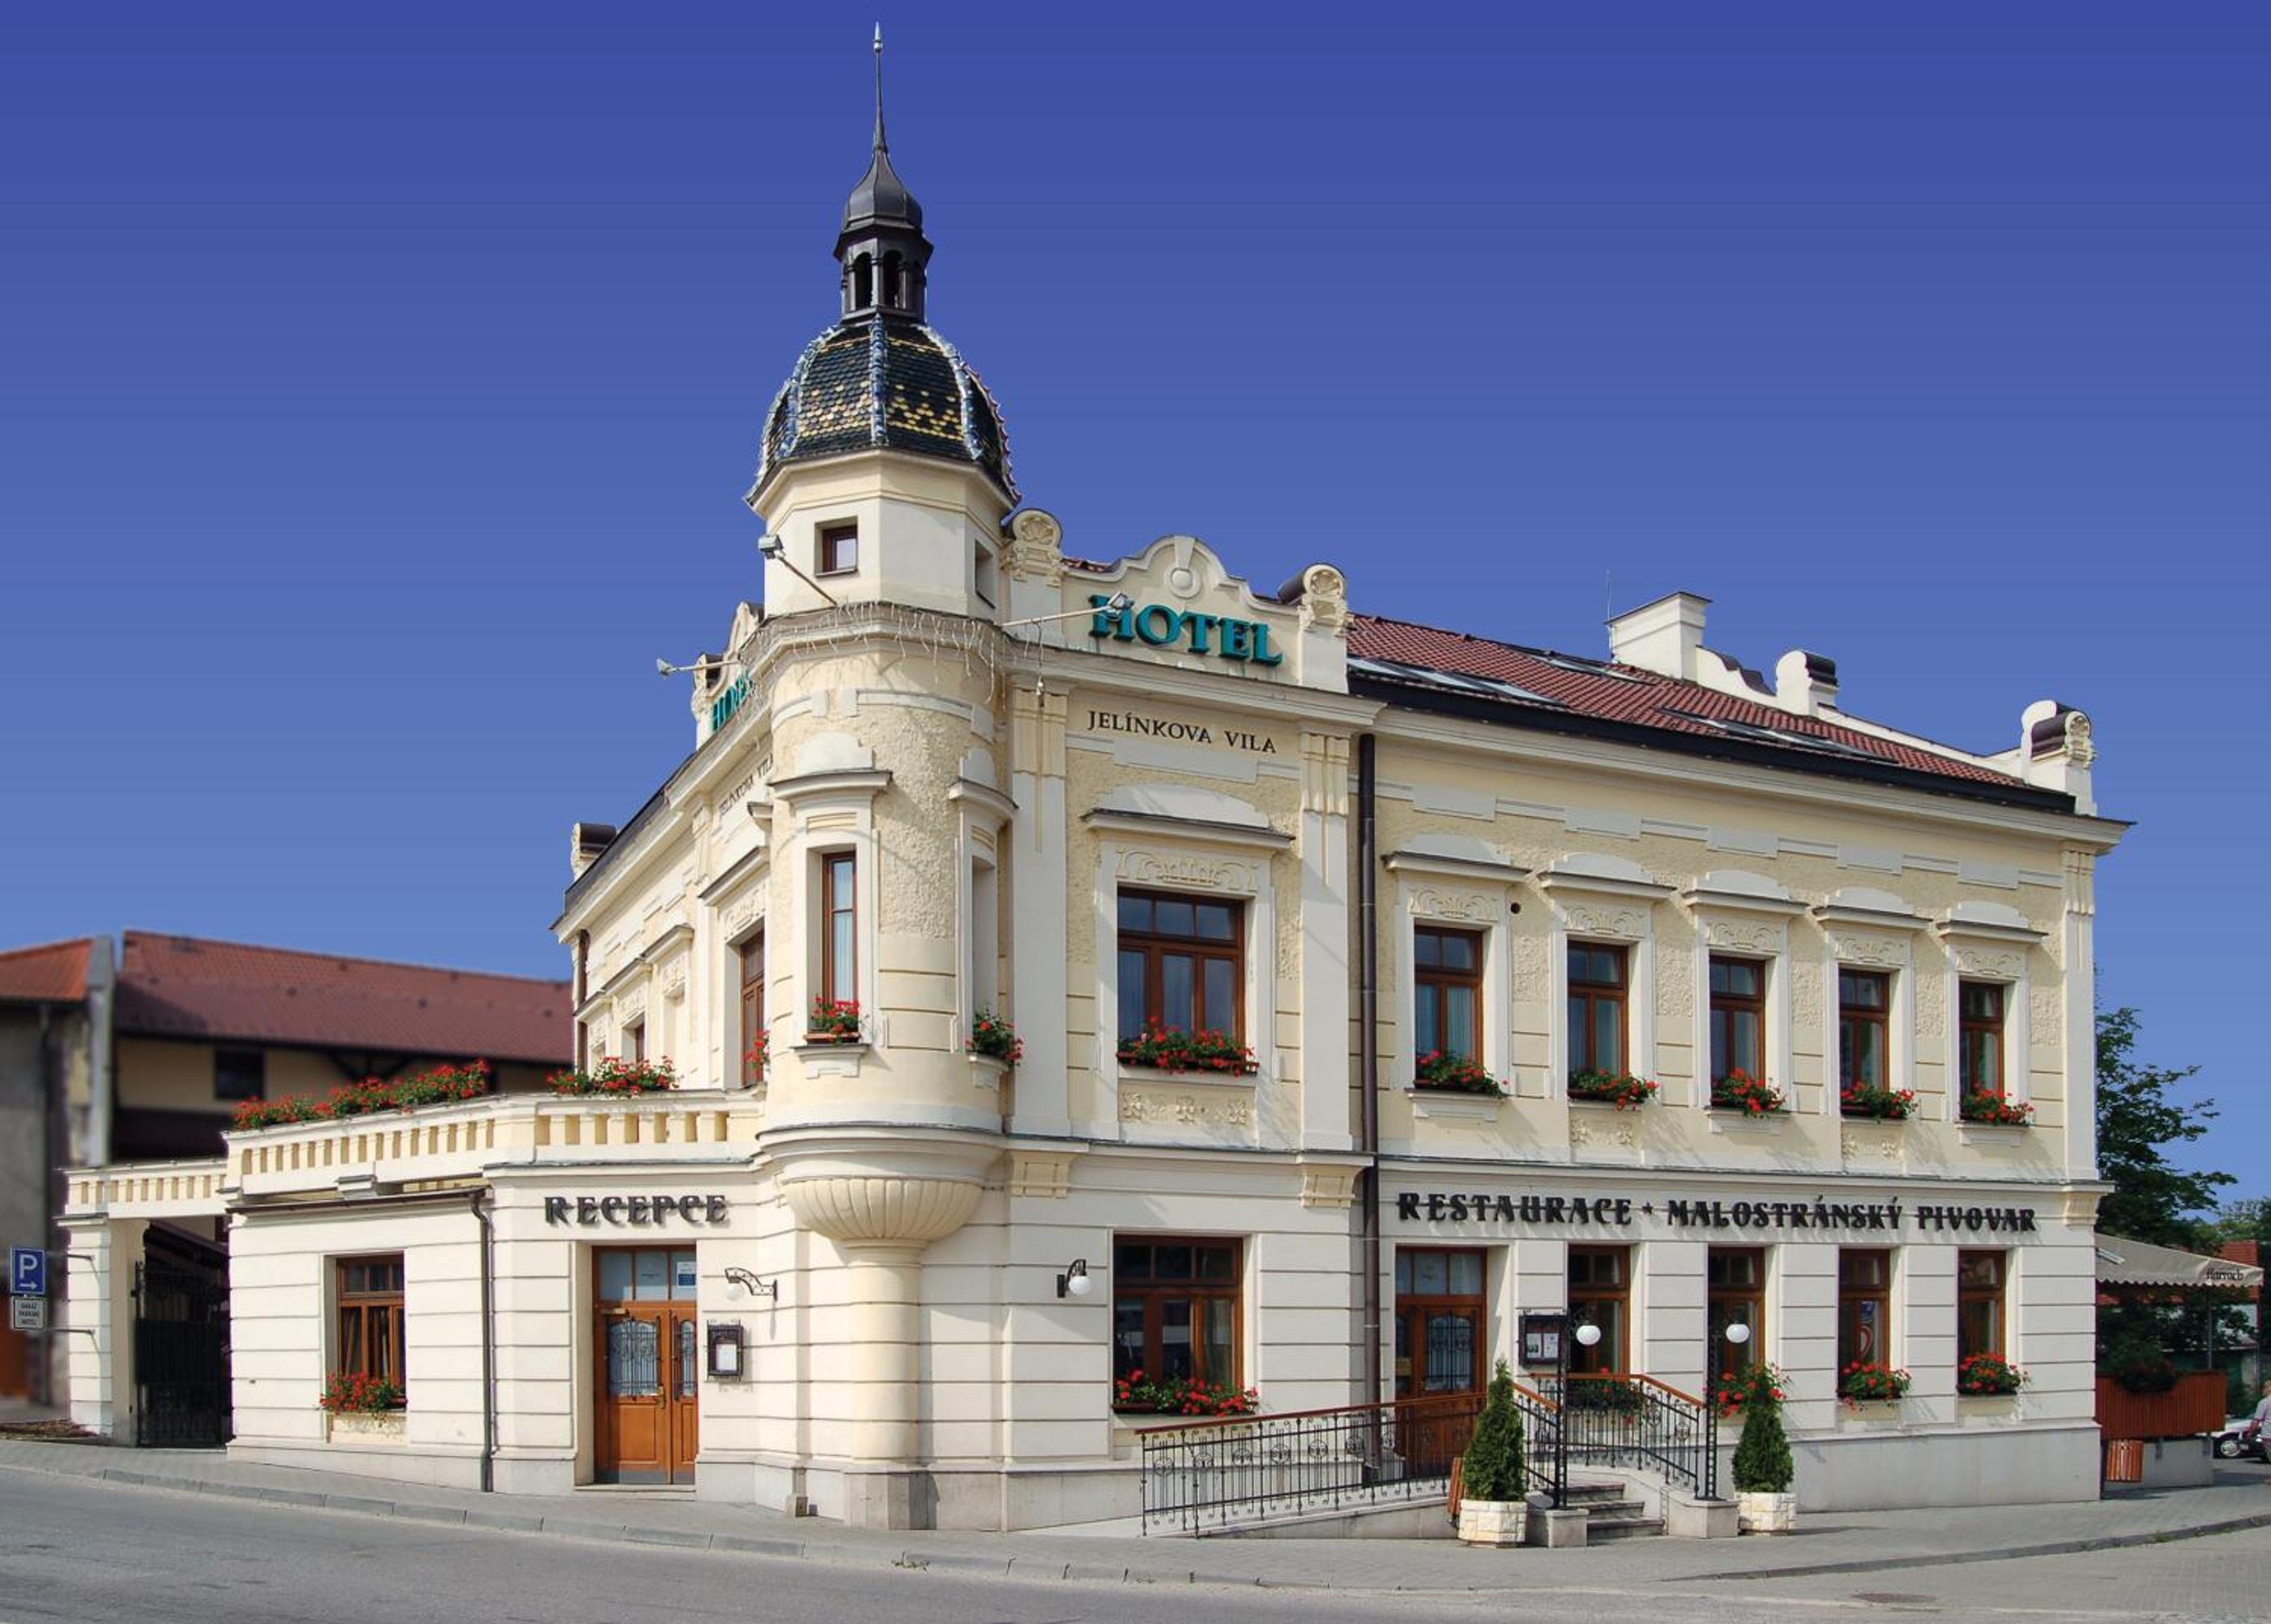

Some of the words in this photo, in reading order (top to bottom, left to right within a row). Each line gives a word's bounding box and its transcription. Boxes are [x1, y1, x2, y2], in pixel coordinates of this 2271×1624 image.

[1088, 593, 1283, 667] HOTEL
[1088, 710, 1212, 745] JELÍNKOVA
[1224, 732, 1277, 754] VILA
[544, 1194, 728, 1224] RECEPCE
[1396, 1192, 1632, 1225] RESTAURACE
[1668, 1194, 1903, 1230] MALOSTRÁNSKÝ
[1917, 1205, 2037, 1233] PIVOVAR
[19, 1254, 38, 1280] P
